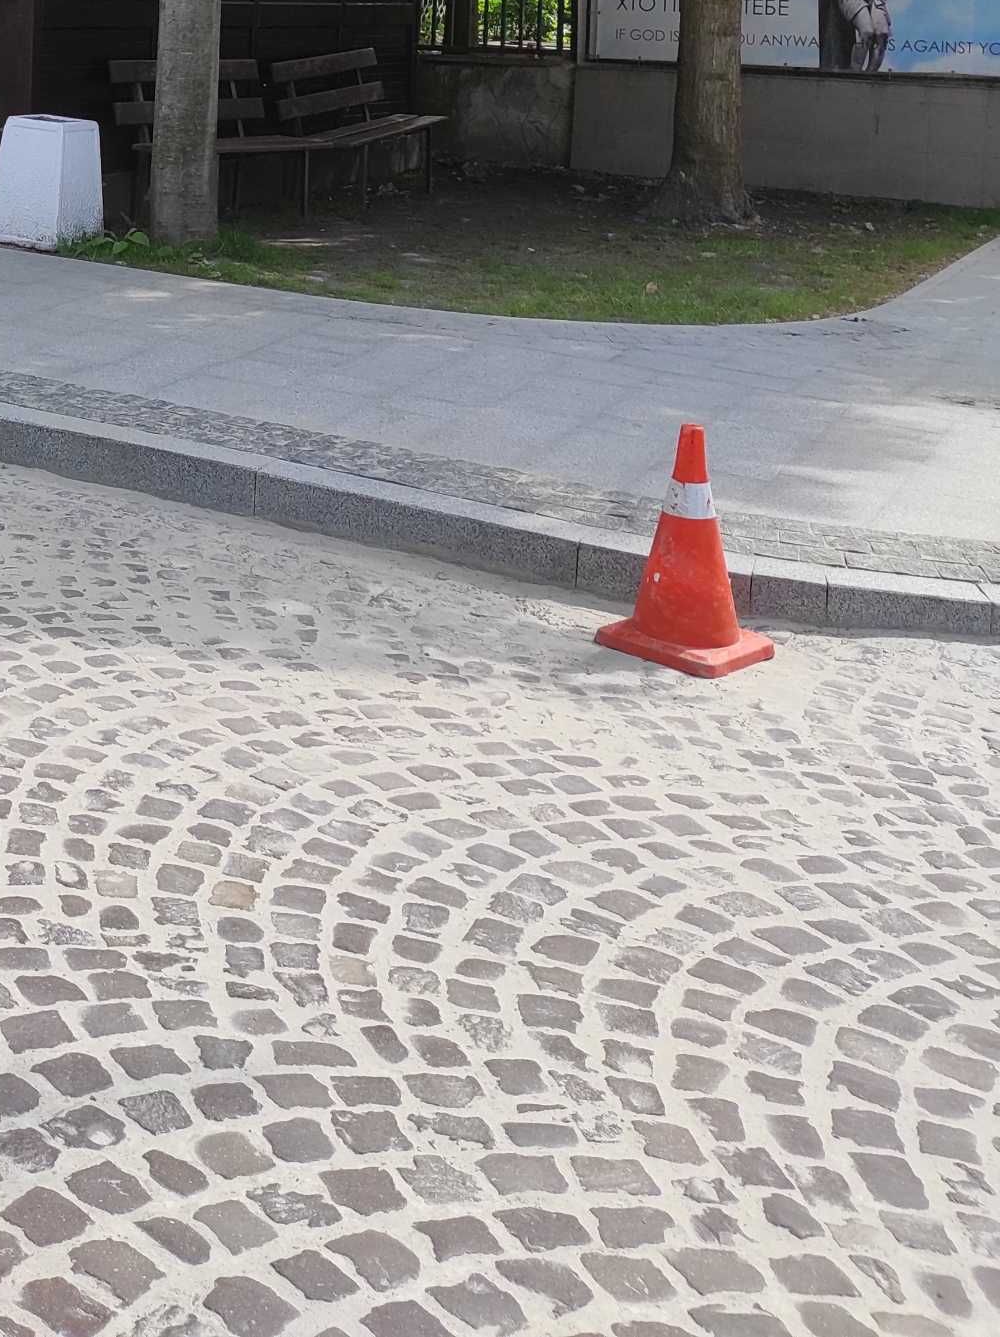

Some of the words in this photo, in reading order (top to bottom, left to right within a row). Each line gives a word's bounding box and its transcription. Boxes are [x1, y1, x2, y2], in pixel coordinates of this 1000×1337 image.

[615, 27, 627, 40] IF
[629, 28, 666, 41] GOD
[760, 33, 821, 48] ANYWA
[901, 39, 974, 55] AGAINST
[979, 41, 1000, 56] YO
